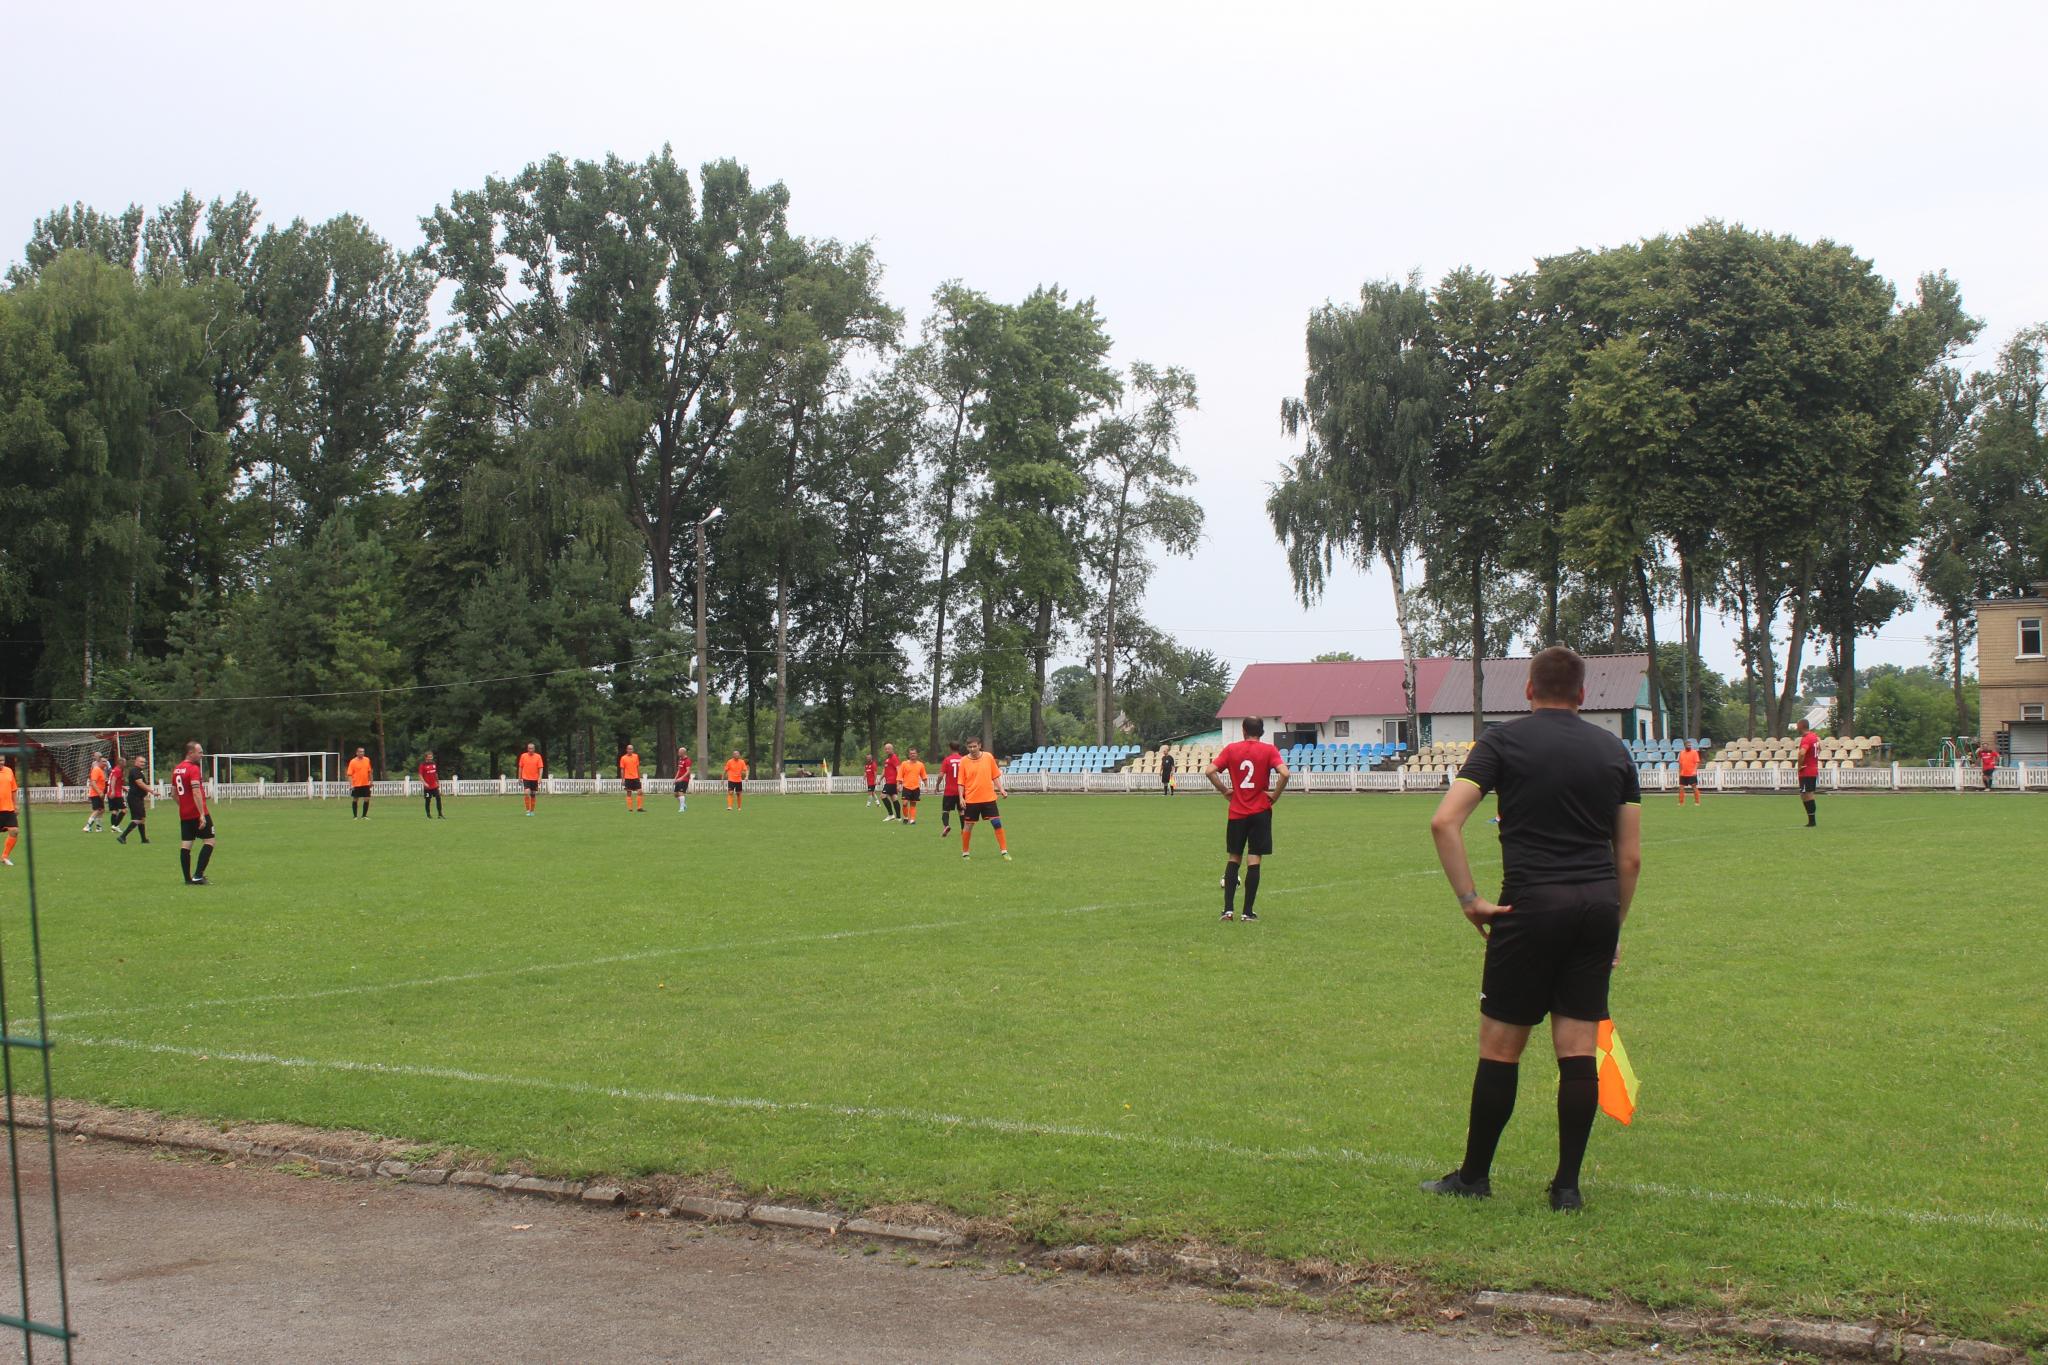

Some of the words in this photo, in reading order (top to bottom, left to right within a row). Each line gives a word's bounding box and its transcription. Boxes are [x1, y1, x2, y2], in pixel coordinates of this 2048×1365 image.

[951, 763, 960, 778] 1
[1240, 759, 1254, 789] 2
[176, 775, 185, 796] 8
